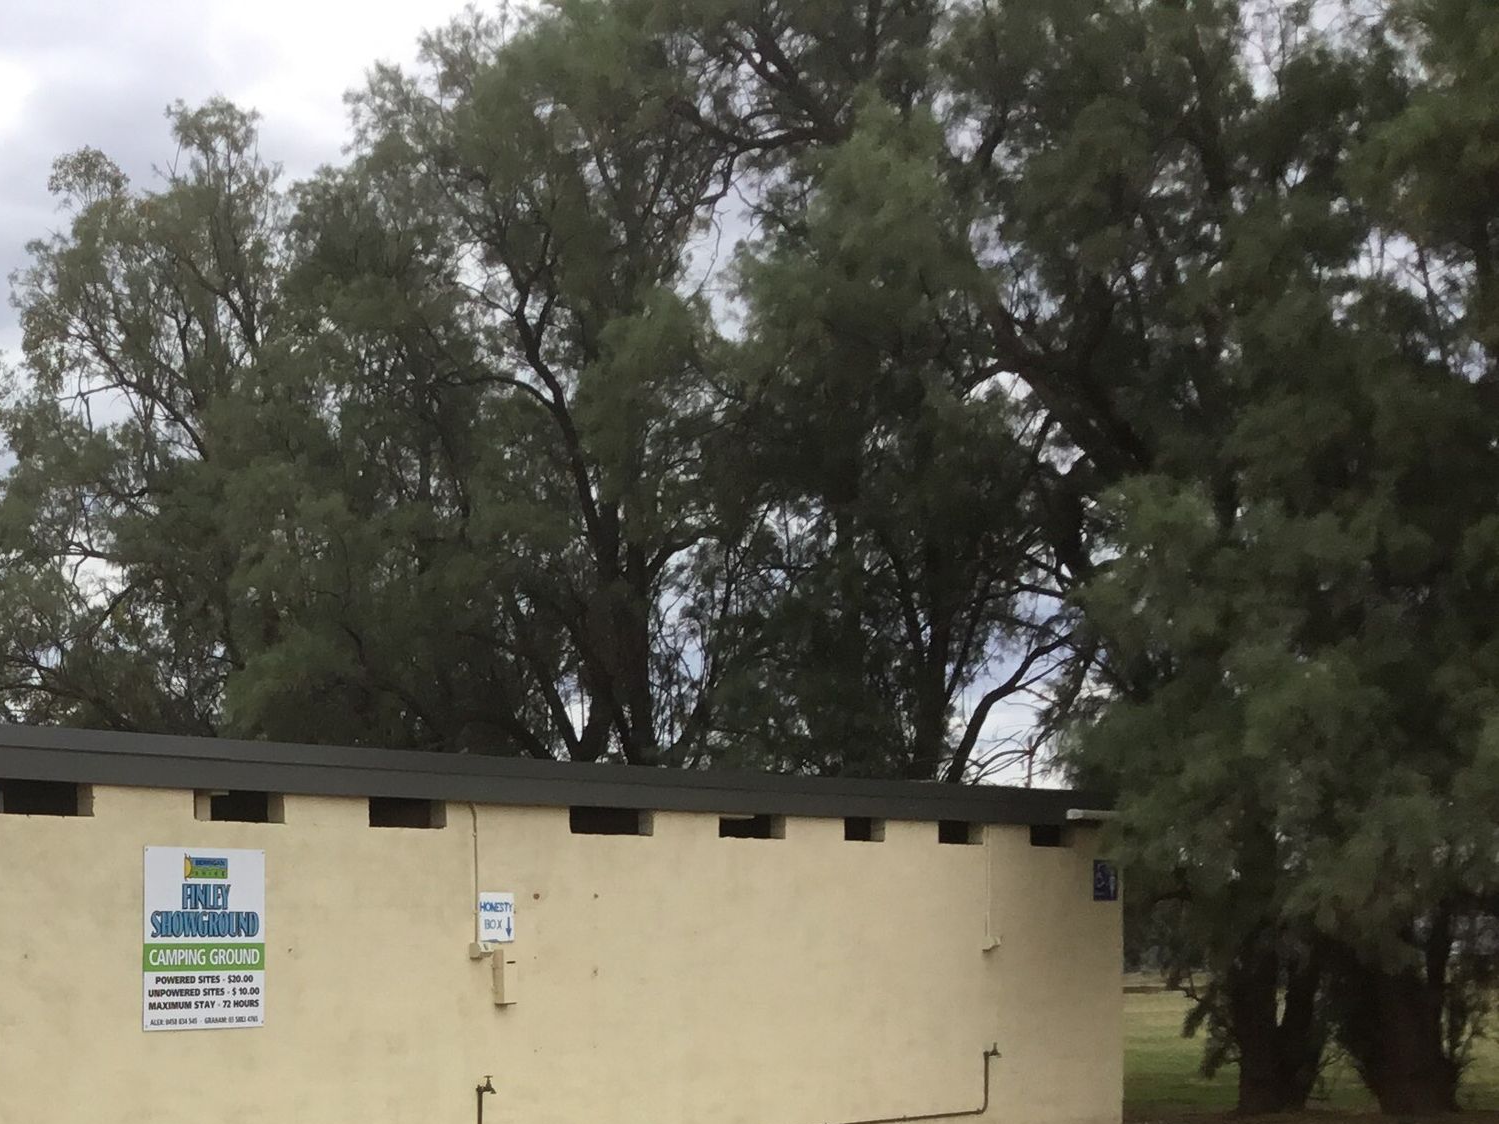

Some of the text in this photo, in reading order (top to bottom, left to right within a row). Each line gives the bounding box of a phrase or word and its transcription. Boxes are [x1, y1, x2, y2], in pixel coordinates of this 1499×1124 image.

[181, 883, 231, 910] FINLEY
[479, 902, 513, 912] HONESTY
[150, 910, 259, 938] SHOWGROUND
[484, 919, 502, 930] BOX
[149, 948, 260, 966] CAMPING GROUND
[155, 976, 196, 984] POWERED
[198, 975, 220, 984] SITES
[227, 974, 254, 984] $20.00
[148, 988, 200, 997] UNPOWERED
[203, 987, 225, 996] SITES
[239, 987, 260, 995] 10.00
[148, 1001, 192, 1010] MAXIMUM
[194, 1000, 215, 1009] STAY
[222, 1000, 231, 1008] 72
[233, 999, 259, 1008] HOURS
